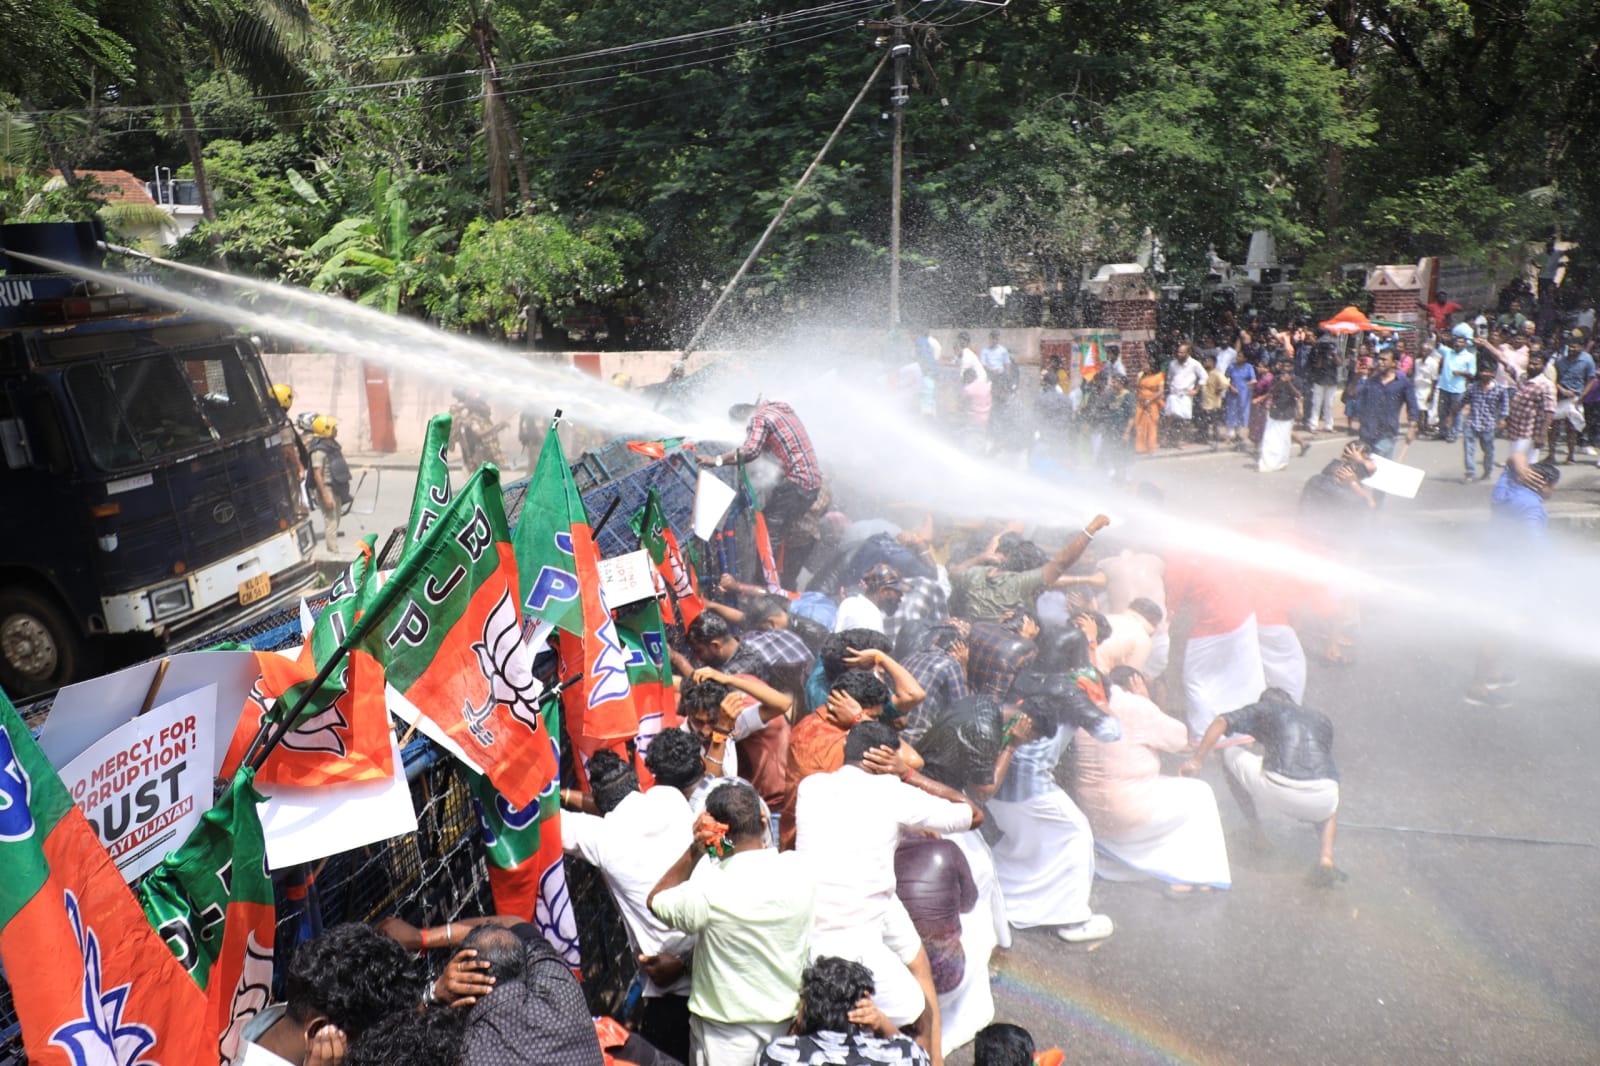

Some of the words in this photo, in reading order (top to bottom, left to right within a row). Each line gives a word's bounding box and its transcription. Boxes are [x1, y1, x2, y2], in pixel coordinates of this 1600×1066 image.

[385, 503, 492, 651] BJP
[91, 735, 155, 788] MERCY
[159, 715, 197, 747] FOR
[109, 834, 133, 858] AYI
[134, 798, 193, 842] VIJAYAN
